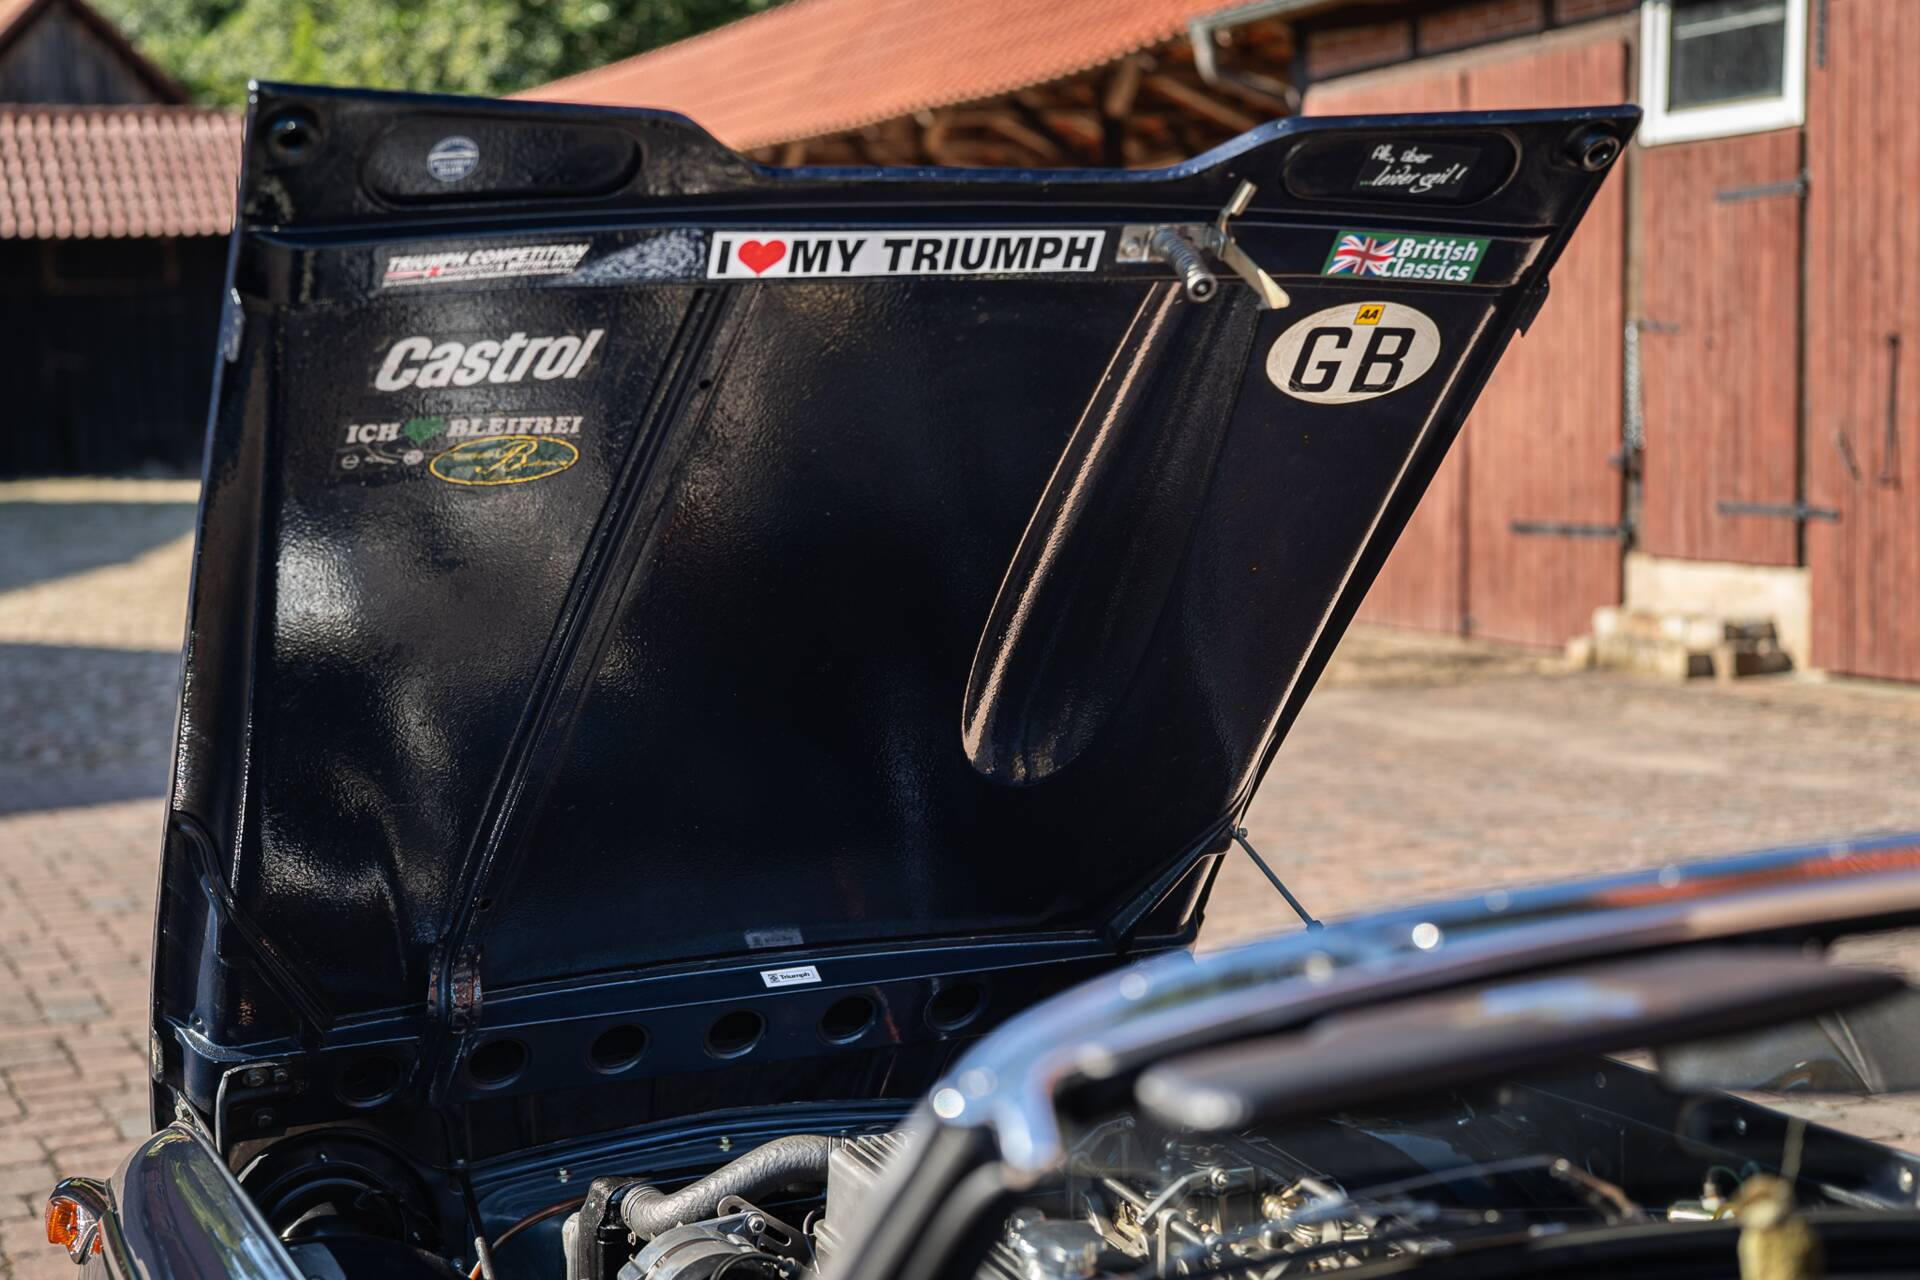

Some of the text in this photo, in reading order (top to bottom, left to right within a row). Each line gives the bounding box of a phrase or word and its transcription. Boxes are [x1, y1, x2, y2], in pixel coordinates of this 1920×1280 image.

[717, 236, 1096, 273] I MY TRIUMPH
[1396, 238, 1479, 262] British
[1379, 257, 1471, 282] Classics
[1358, 308, 1379, 320] AA
[374, 329, 605, 391] Castrol
[1288, 326, 1416, 393] GB
[346, 416, 584, 444] ICH BLEIFREI
[780, 971, 810, 980] Triumph
